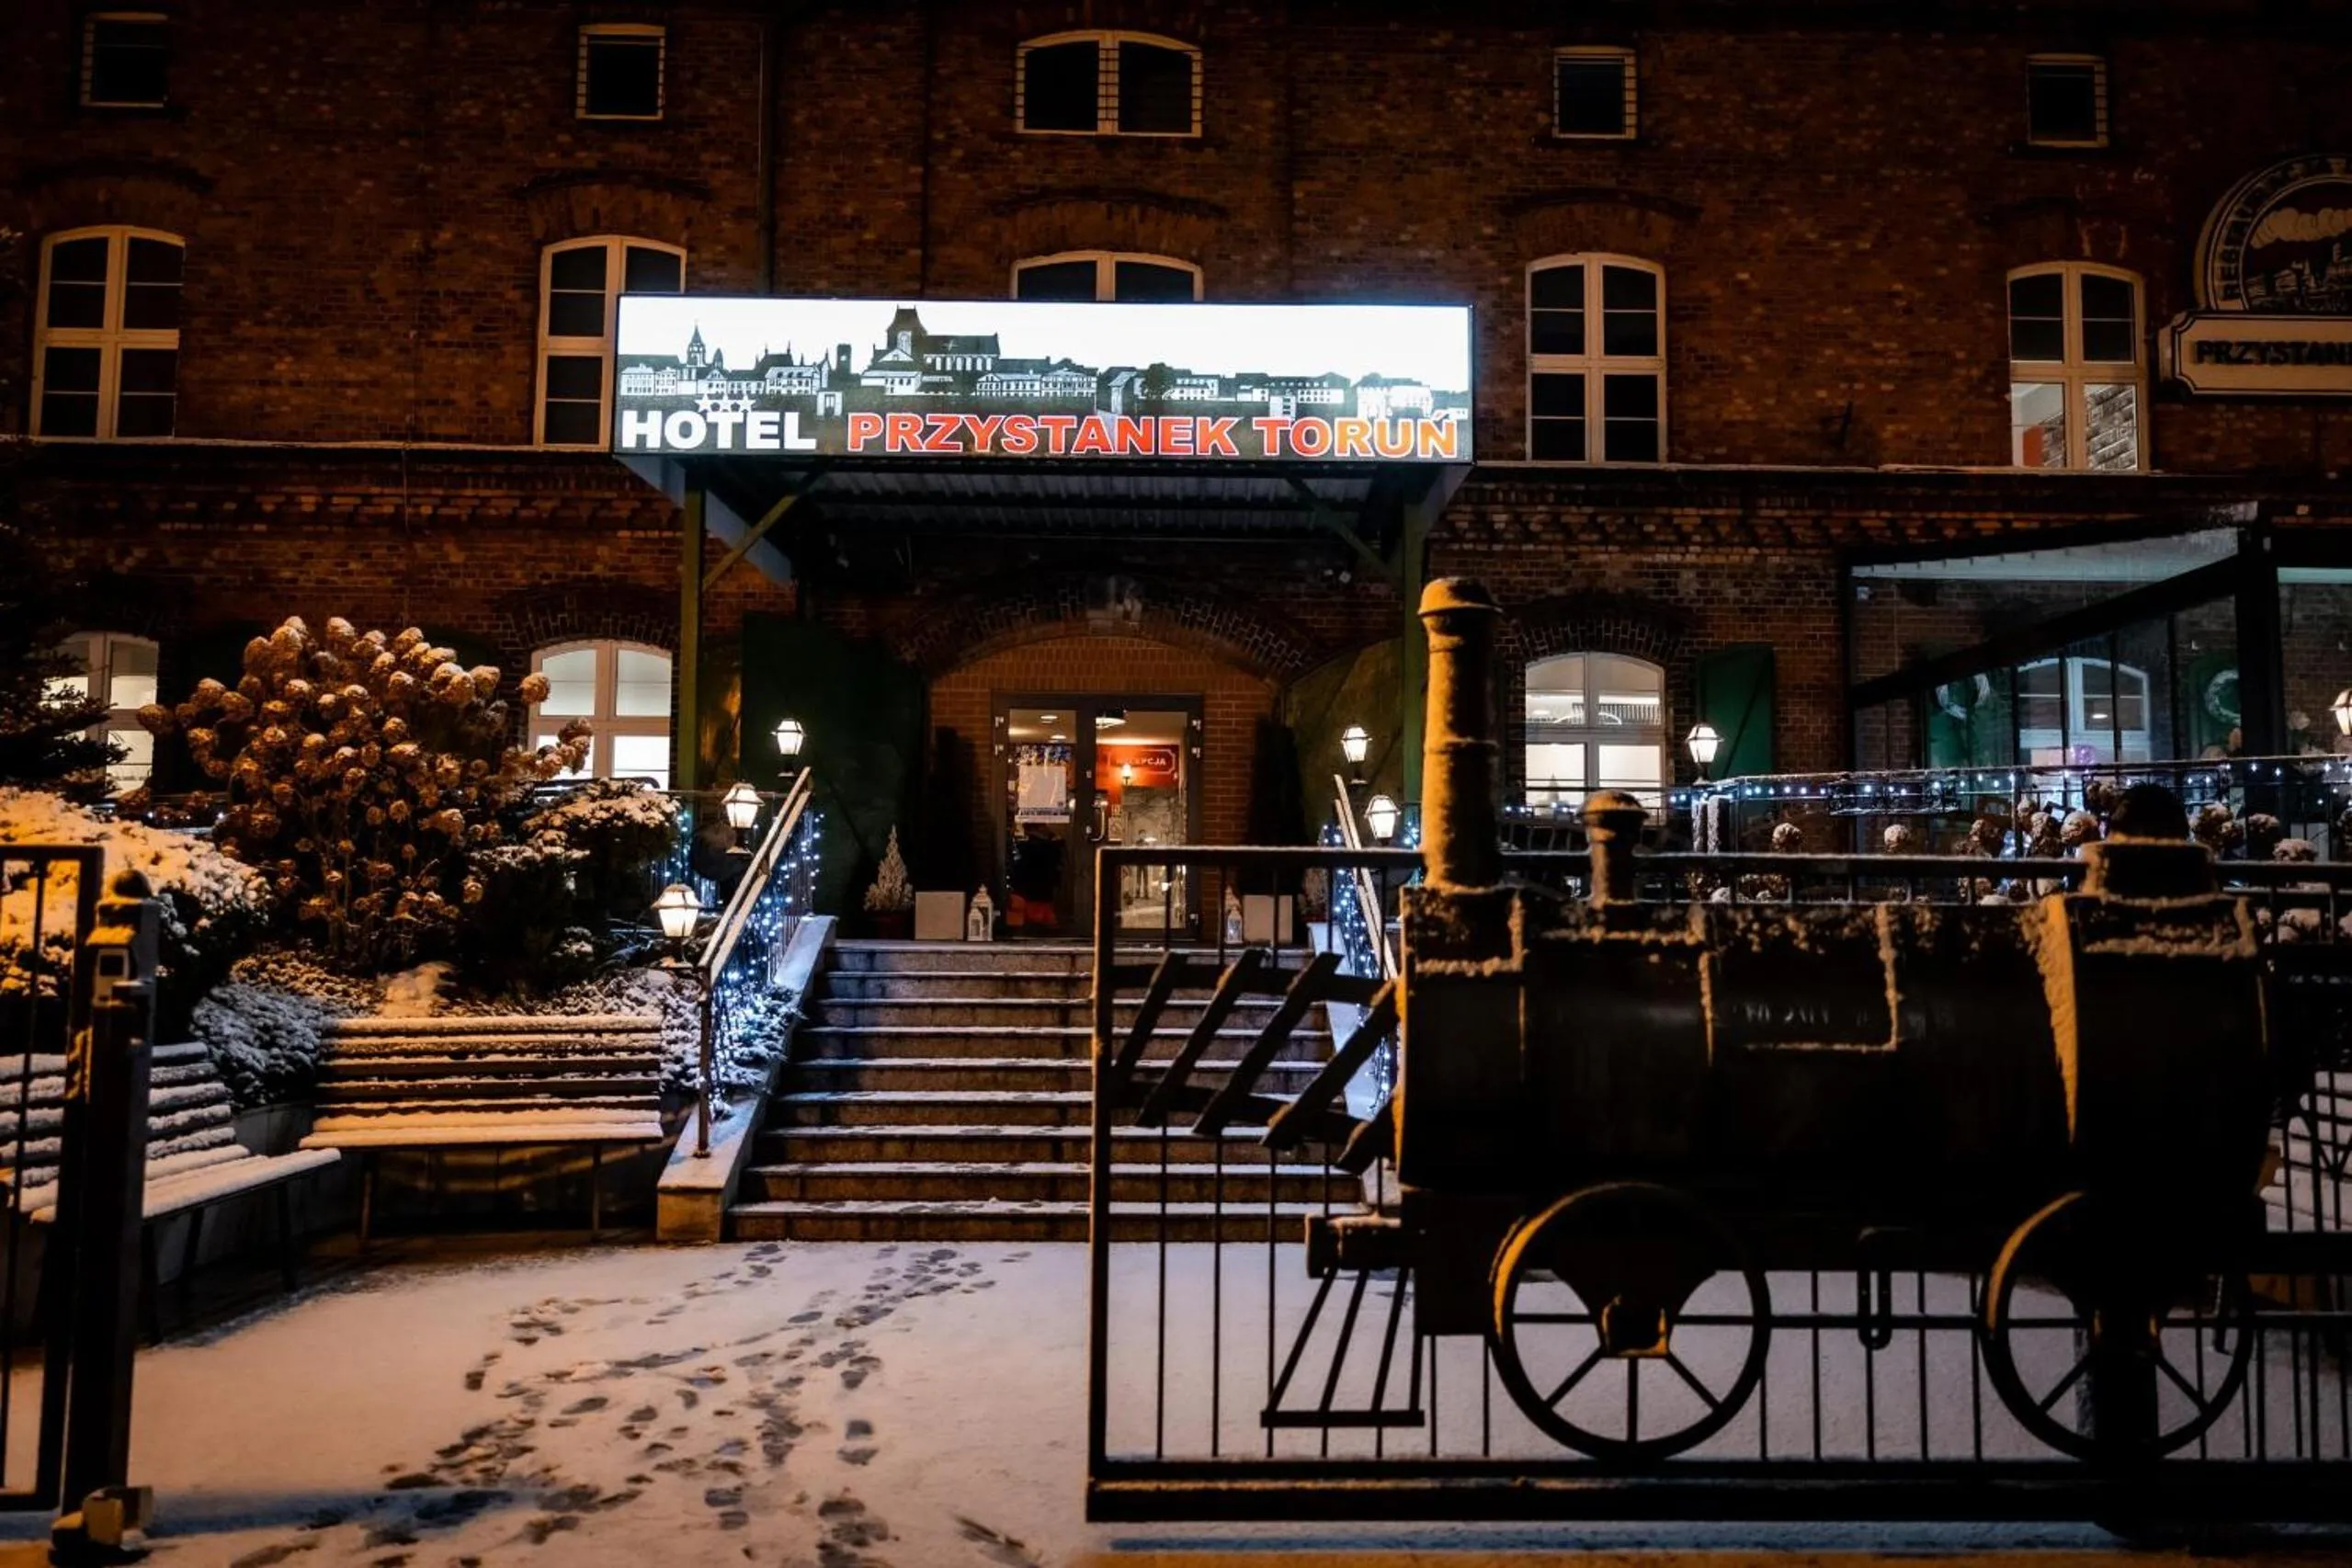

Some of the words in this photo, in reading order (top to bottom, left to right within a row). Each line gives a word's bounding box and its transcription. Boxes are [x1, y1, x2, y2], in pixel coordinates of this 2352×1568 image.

[621, 411, 816, 449] HOTEL
[846, 413, 1239, 456] PRZYSTANEK
[1253, 410, 1457, 457] TORUŃ
